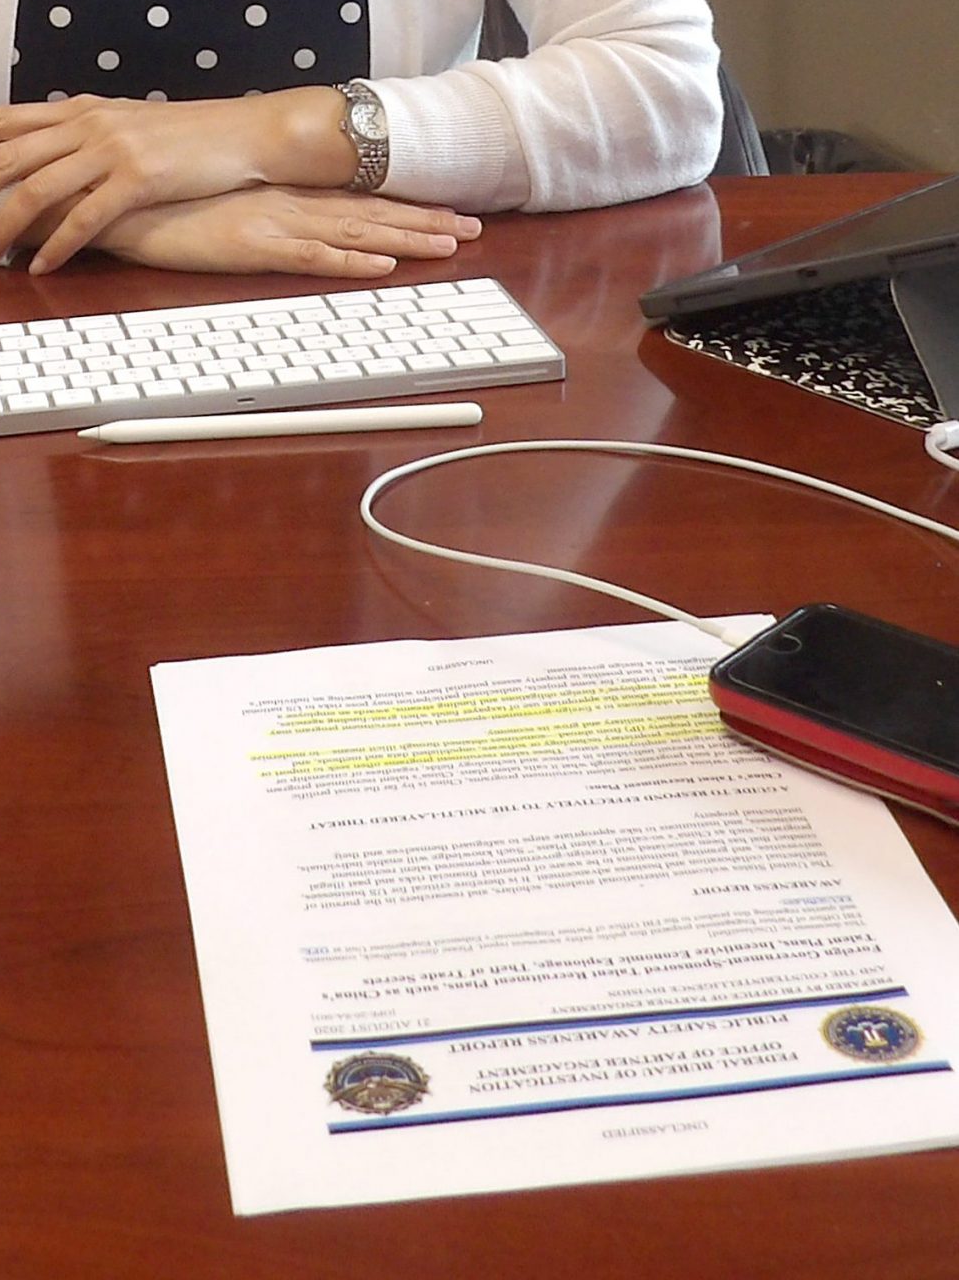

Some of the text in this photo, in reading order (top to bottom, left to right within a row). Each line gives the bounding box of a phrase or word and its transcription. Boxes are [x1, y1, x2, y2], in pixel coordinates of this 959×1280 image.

[427, 658, 493, 671] UNCLASSIFIED
[622, 777, 695, 789] Recruitment
[697, 775, 734, 784] Talent
[736, 772, 783, 781] China's
[642, 790, 707, 801] RESPOND
[708, 789, 729, 797] TO
[732, 786, 778, 795] GUIDE
[489, 805, 517, 813] THE
[545, 795, 640, 808] EFFECTIVELY
[369, 807, 486, 824] MULTI-LAYERED
[308, 818, 365, 830] THREAT
[689, 878, 844, 895] AWARENESS REPORT
[362, 933, 875, 987] Talent Plans, Incentivize Economic Espionage, Theft of Trade Secrets
[321, 942, 883, 1002] Foreign Government-Sponsored Talent Recruitment Plans, such as China's
[606, 965, 888, 999] AND THE COUNTERINTELLIGENCE DIVISION
[549, 977, 895, 1016] PREPARED BY FBI OFFICE OF PARTNER ENGAGEMENT
[313, 1018, 431, 1034] 21 AUGUST 2020
[446, 1013, 790, 1052] PUBLIC SAFETY AWARENESS REPORT
[473, 1042, 784, 1079] OFFICE OF PARTNER ENGAGEMENT
[467, 1052, 799, 1093] FEDERAL BUREAU OF INVESTIGATION
[600, 1120, 709, 1139] UNCLASSIFIED
